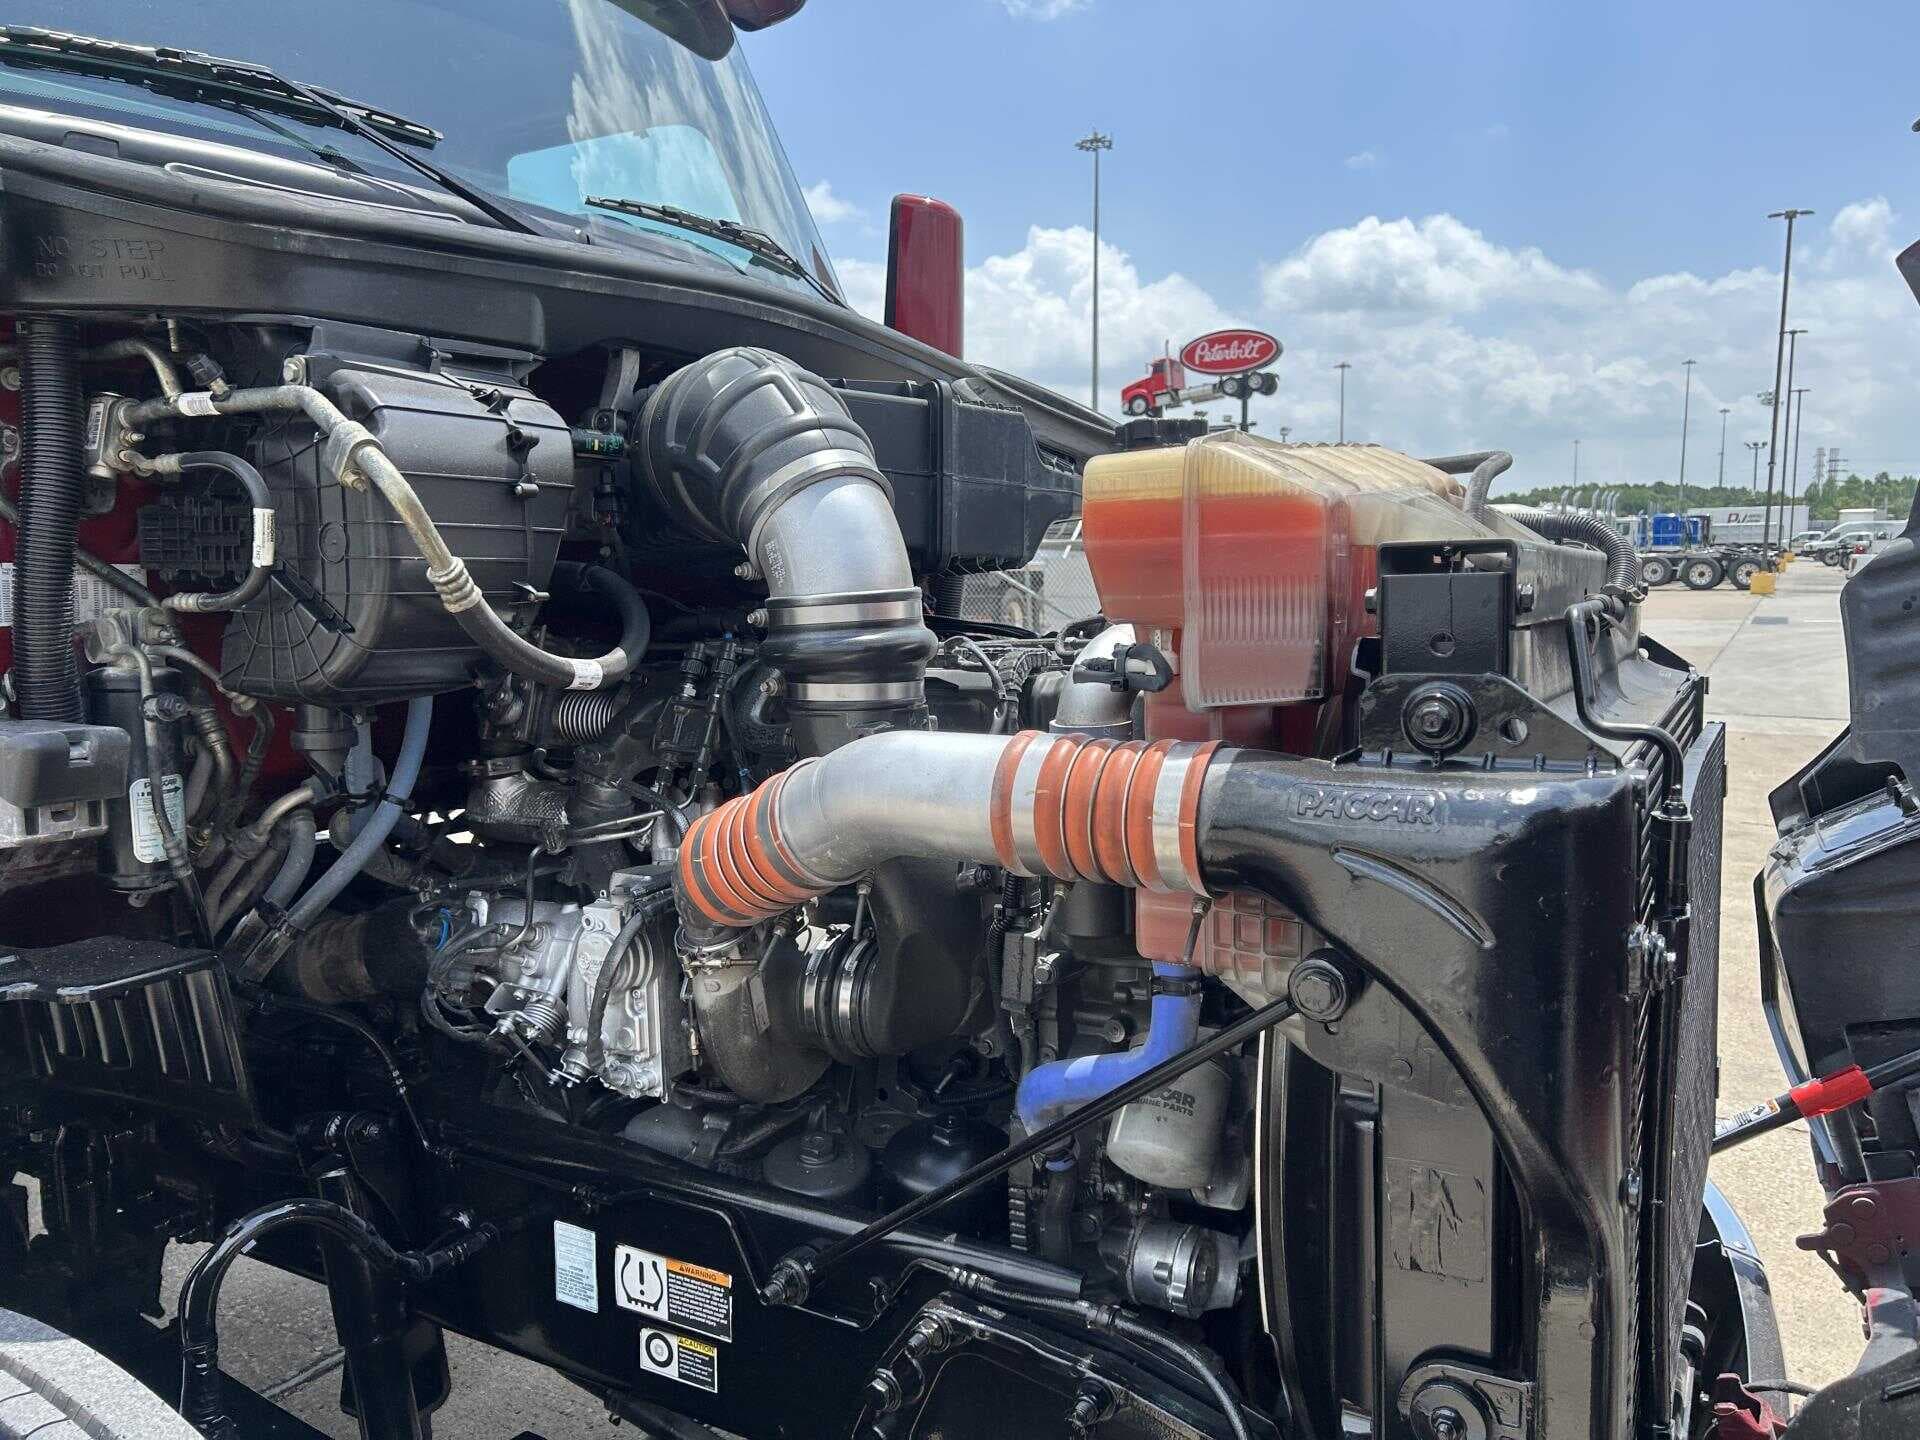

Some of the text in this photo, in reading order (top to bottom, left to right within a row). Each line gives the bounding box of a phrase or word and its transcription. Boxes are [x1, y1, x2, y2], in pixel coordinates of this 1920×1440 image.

[89, 237, 166, 260] STEP
[119, 264, 176, 281] PULL
[1194, 339, 1267, 365] Peterbilt
[1297, 791, 1435, 825] PACCAR
[1163, 1101, 1194, 1117] PARTS
[684, 1266, 717, 1282] WARNING
[684, 1339, 714, 1355] CAUTION
